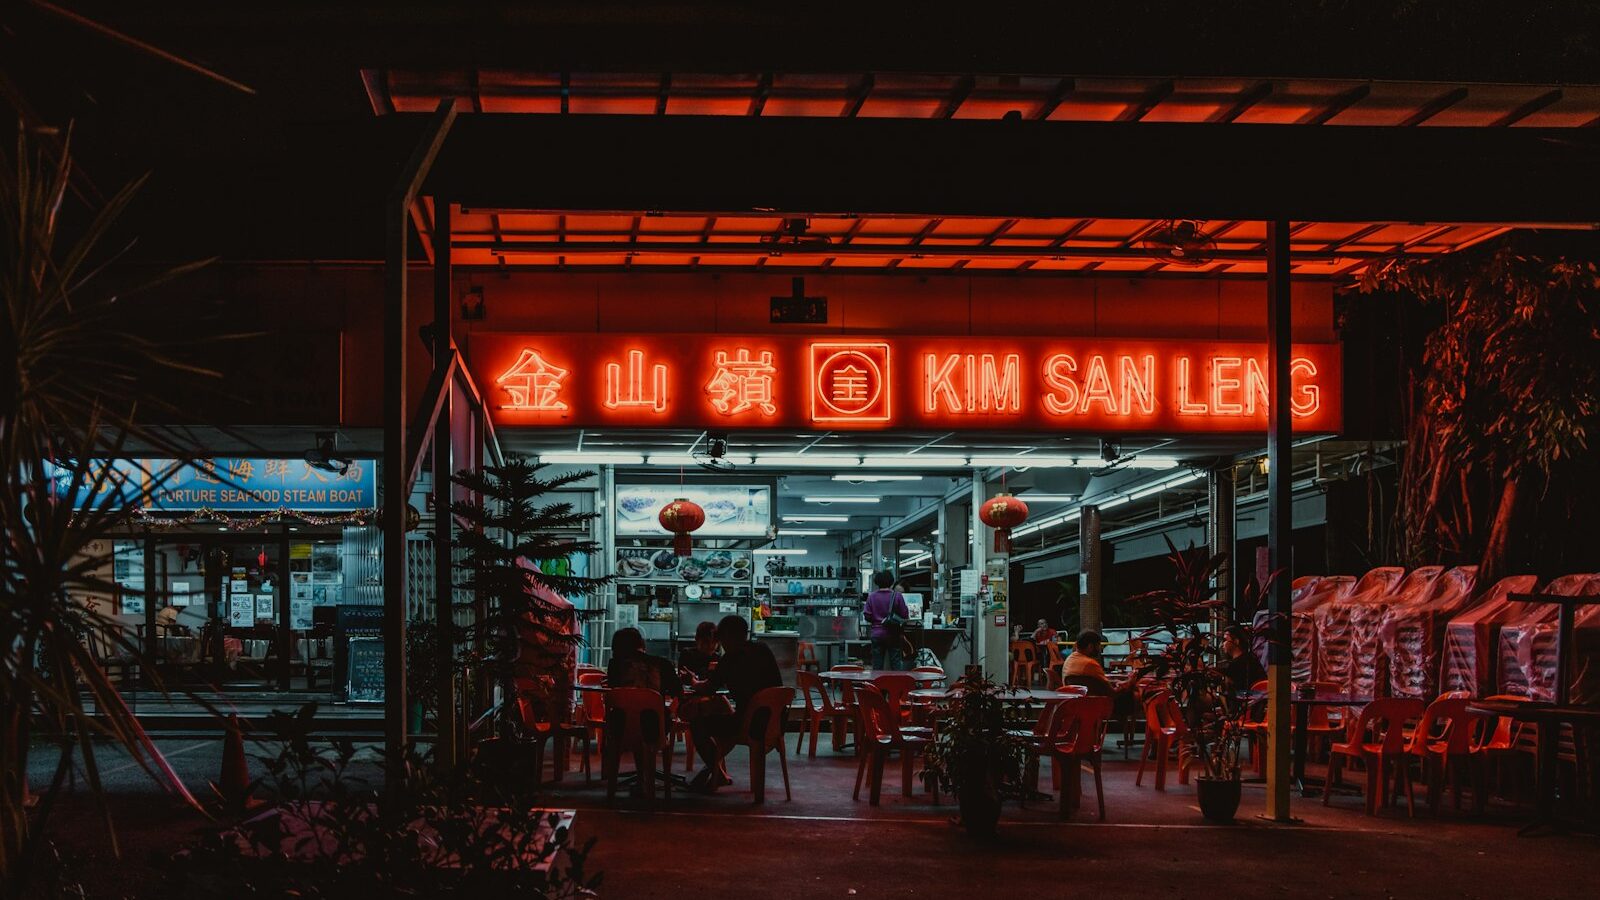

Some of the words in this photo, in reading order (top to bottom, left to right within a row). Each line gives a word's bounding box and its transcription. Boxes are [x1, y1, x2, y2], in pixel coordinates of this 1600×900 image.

[495, 348, 777, 416] 金山嶺
[924, 352, 1021, 414] KIM
[1042, 353, 1156, 416] SAN
[1176, 356, 1321, 418] LENG
[158, 489, 217, 503] FORTURE
[220, 489, 281, 503] SEAFOOD
[283, 489, 327, 503] STEAM
[329, 489, 364, 503] BOAT
